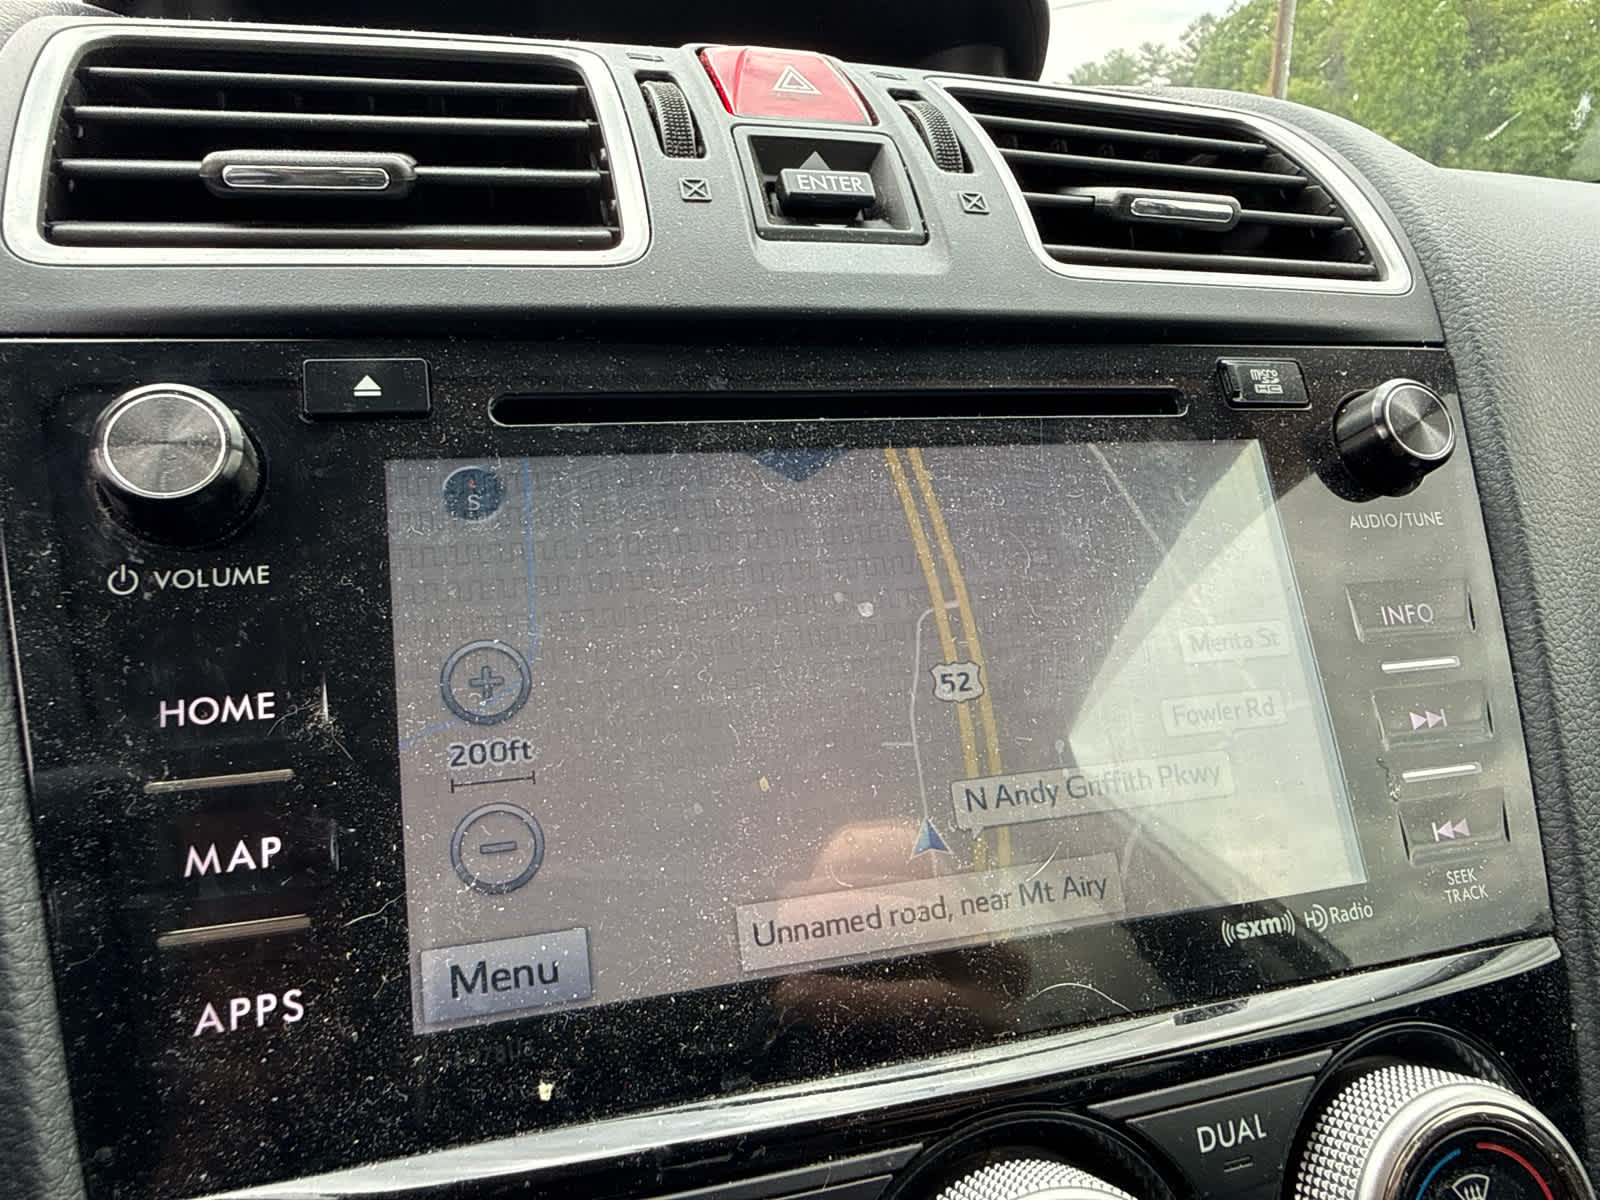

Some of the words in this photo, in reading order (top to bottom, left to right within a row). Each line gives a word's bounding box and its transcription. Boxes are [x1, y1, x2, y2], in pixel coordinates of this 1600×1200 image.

[796, 174, 866, 193] ENTER
[467, 493, 481, 511] S
[1349, 511, 1445, 530] AUDIO/TUNE
[153, 565, 271, 590] VOLUME
[1380, 603, 1434, 626] INFO
[940, 672, 973, 693] 52
[159, 691, 276, 729] HOME
[1171, 701, 1241, 727] Fowler
[1245, 696, 1275, 720] Rd
[450, 739, 533, 768] 200ft
[965, 786, 988, 812] N
[996, 780, 1058, 808] Andy
[1065, 767, 1151, 800] Griffith
[1157, 764, 1221, 789] Pkwy
[184, 836, 282, 878] MAP
[1446, 867, 1478, 886] SEEK
[1443, 884, 1489, 904] TRACK
[752, 905, 883, 947] Unnamed
[888, 896, 954, 926] road,
[960, 890, 1013, 917] near
[1018, 880, 1055, 907] Mt
[1063, 875, 1108, 902] Airy
[1304, 903, 1329, 933] HD
[1331, 903, 1374, 925] Radio
[450, 957, 560, 999] Menu
[193, 989, 305, 1038] APPS
[1196, 1113, 1268, 1154] DUAL
